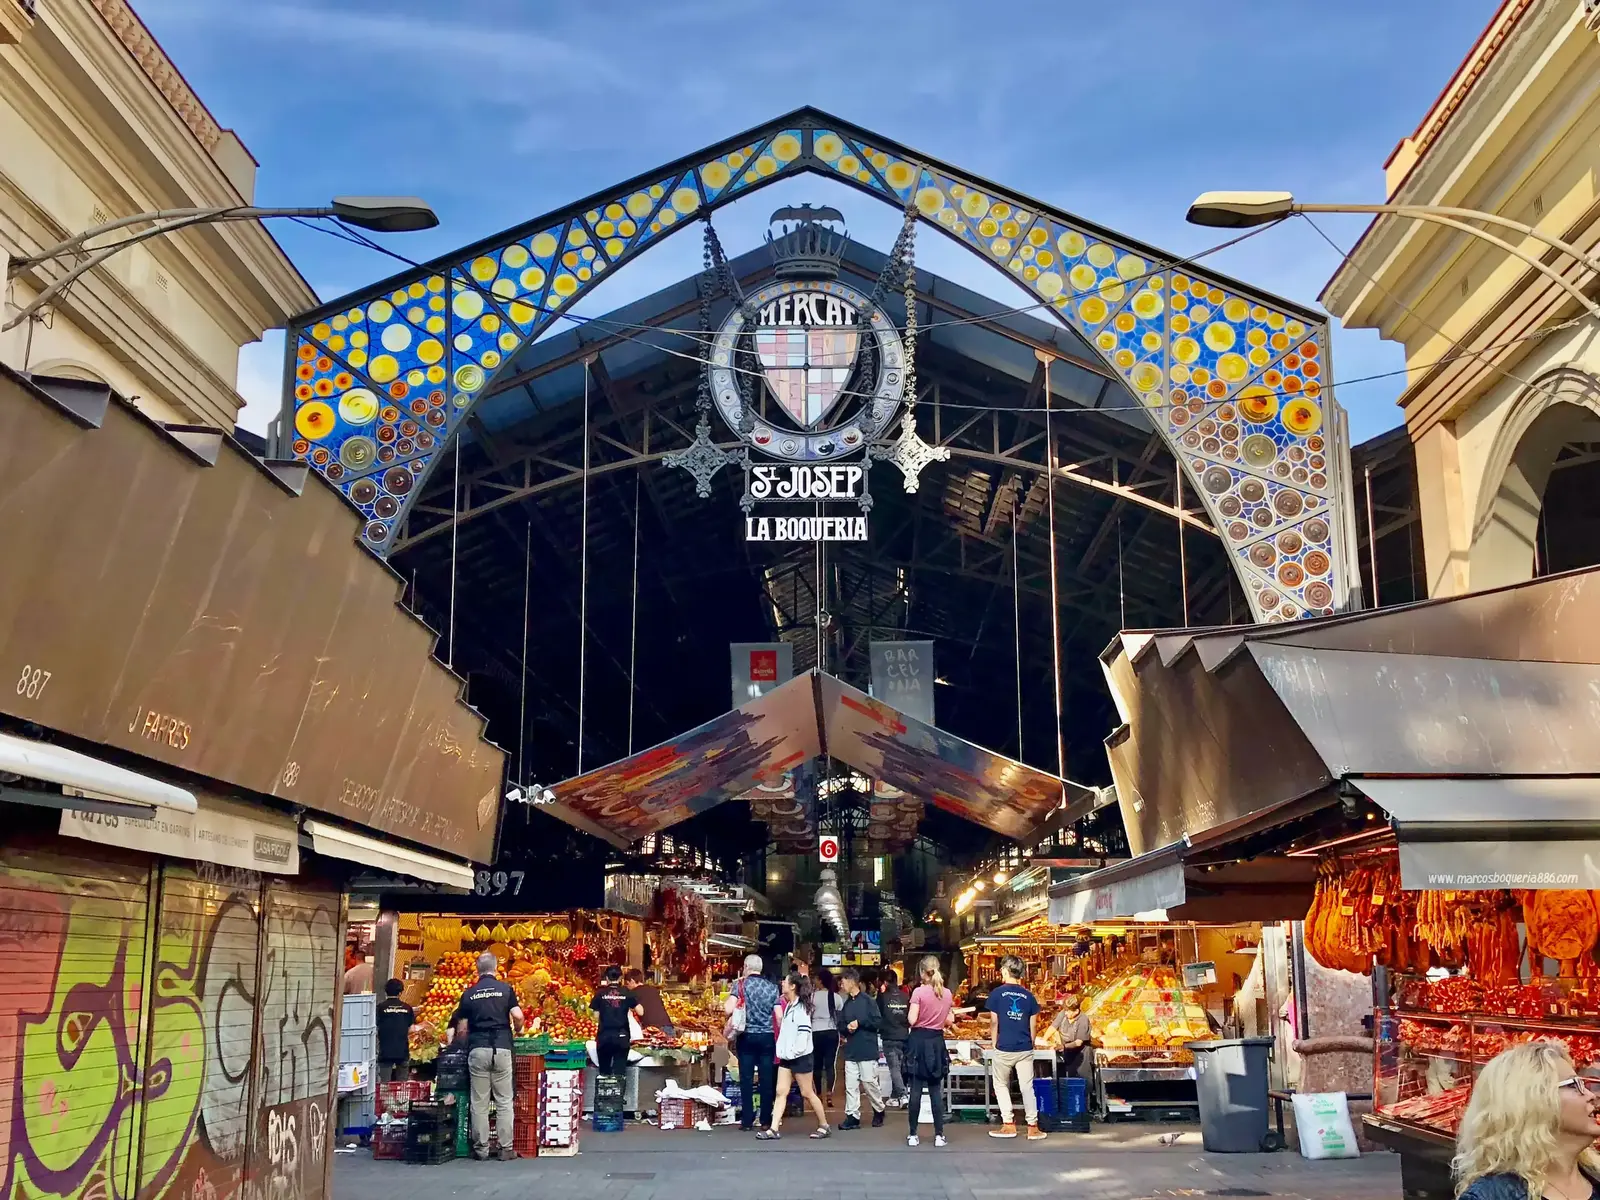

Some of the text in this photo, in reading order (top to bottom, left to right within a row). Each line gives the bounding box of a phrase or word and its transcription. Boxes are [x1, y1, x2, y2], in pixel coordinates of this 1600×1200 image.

[760, 293, 856, 326] MERCAT
[776, 466, 862, 498] JOSEP
[746, 516, 868, 541] LA BOQUERIA
[16, 664, 52, 700] 887
[128, 705, 192, 750] J FARRES
[825, 843, 833, 856] 6
[475, 870, 525, 897] 897
[1428, 871, 1579, 886] www.marcosboqueria886.com
